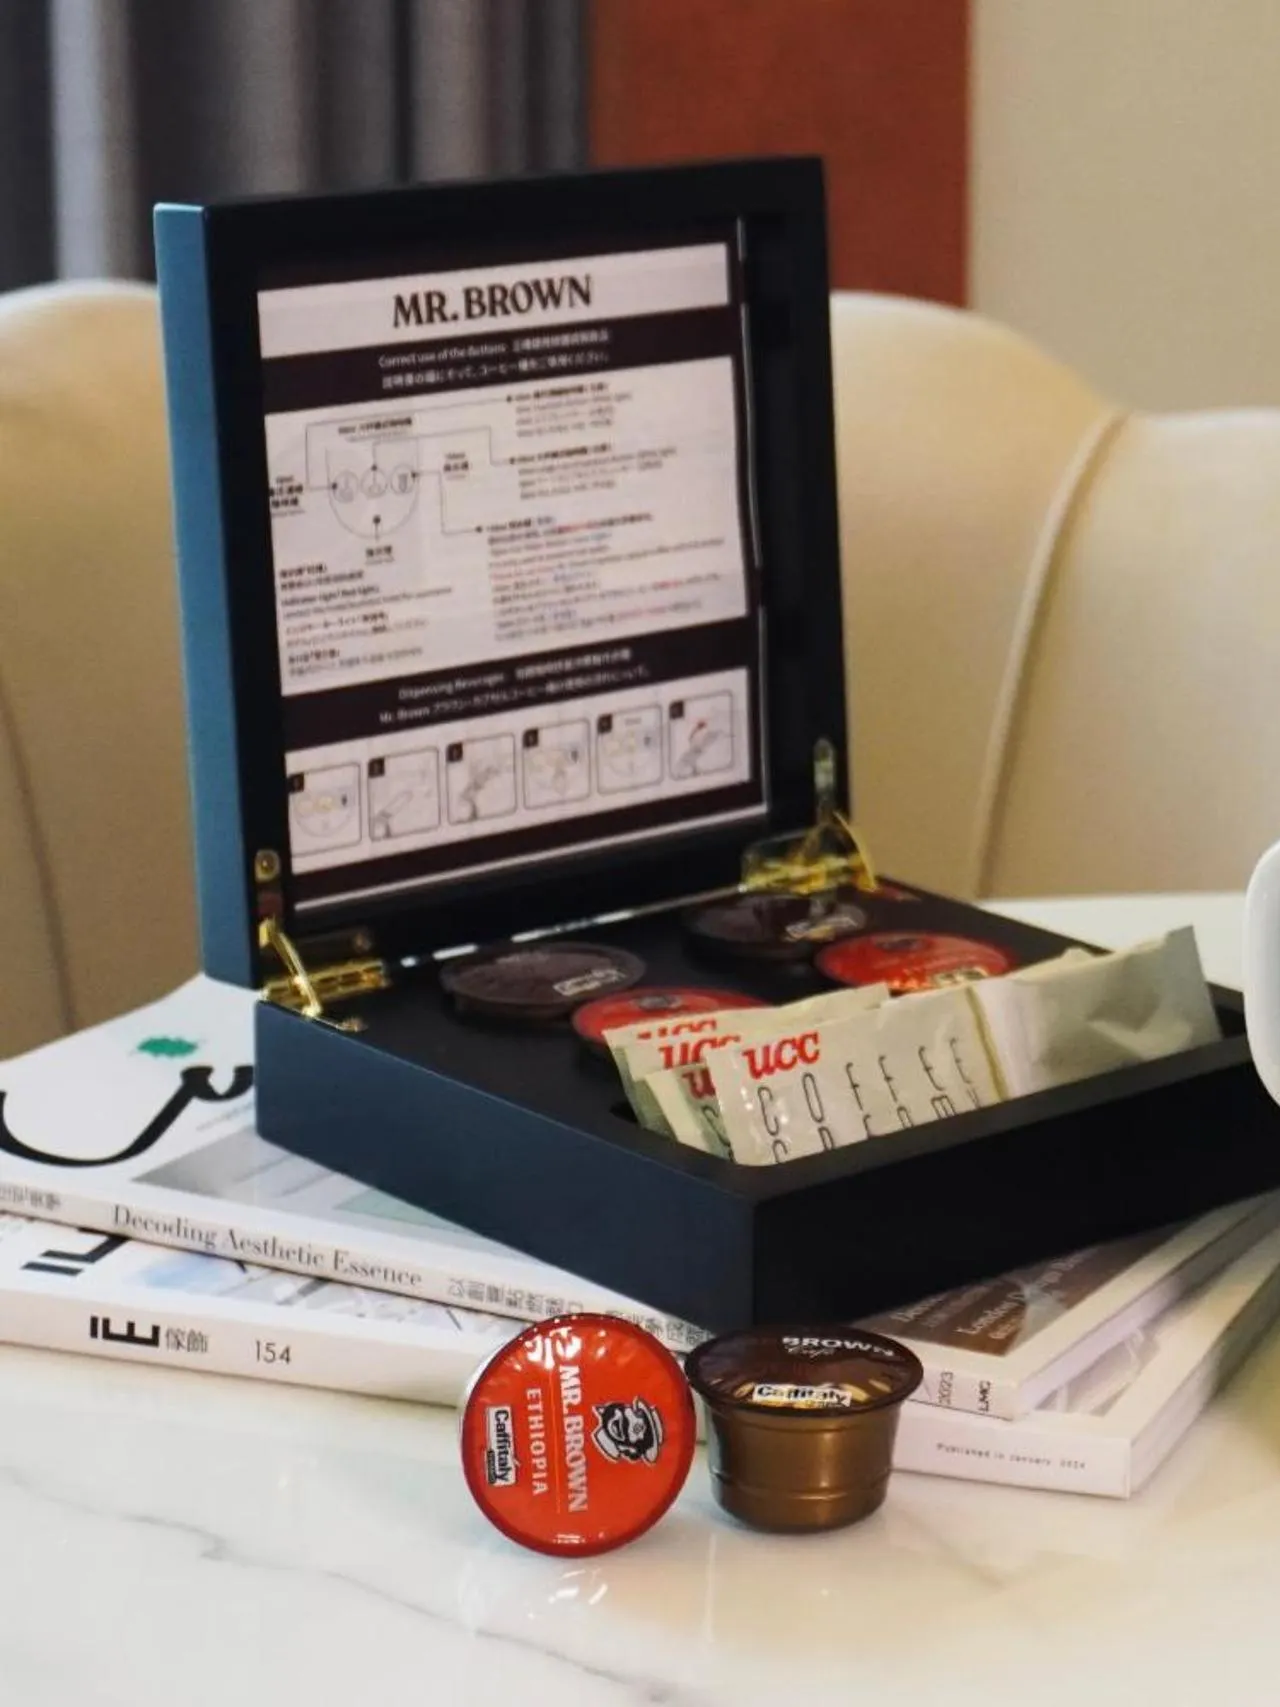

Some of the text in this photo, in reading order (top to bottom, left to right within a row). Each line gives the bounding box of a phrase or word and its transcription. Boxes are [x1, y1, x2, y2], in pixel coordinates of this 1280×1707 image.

[113, 1203, 423, 1287] Decoding Aesthetic Essence
[256, 1339, 291, 1364] 154
[494, 1408, 513, 1484] Caffitaly
[526, 1388, 549, 1495] ETHIOPIA
[563, 1415, 588, 1513] BROWN
